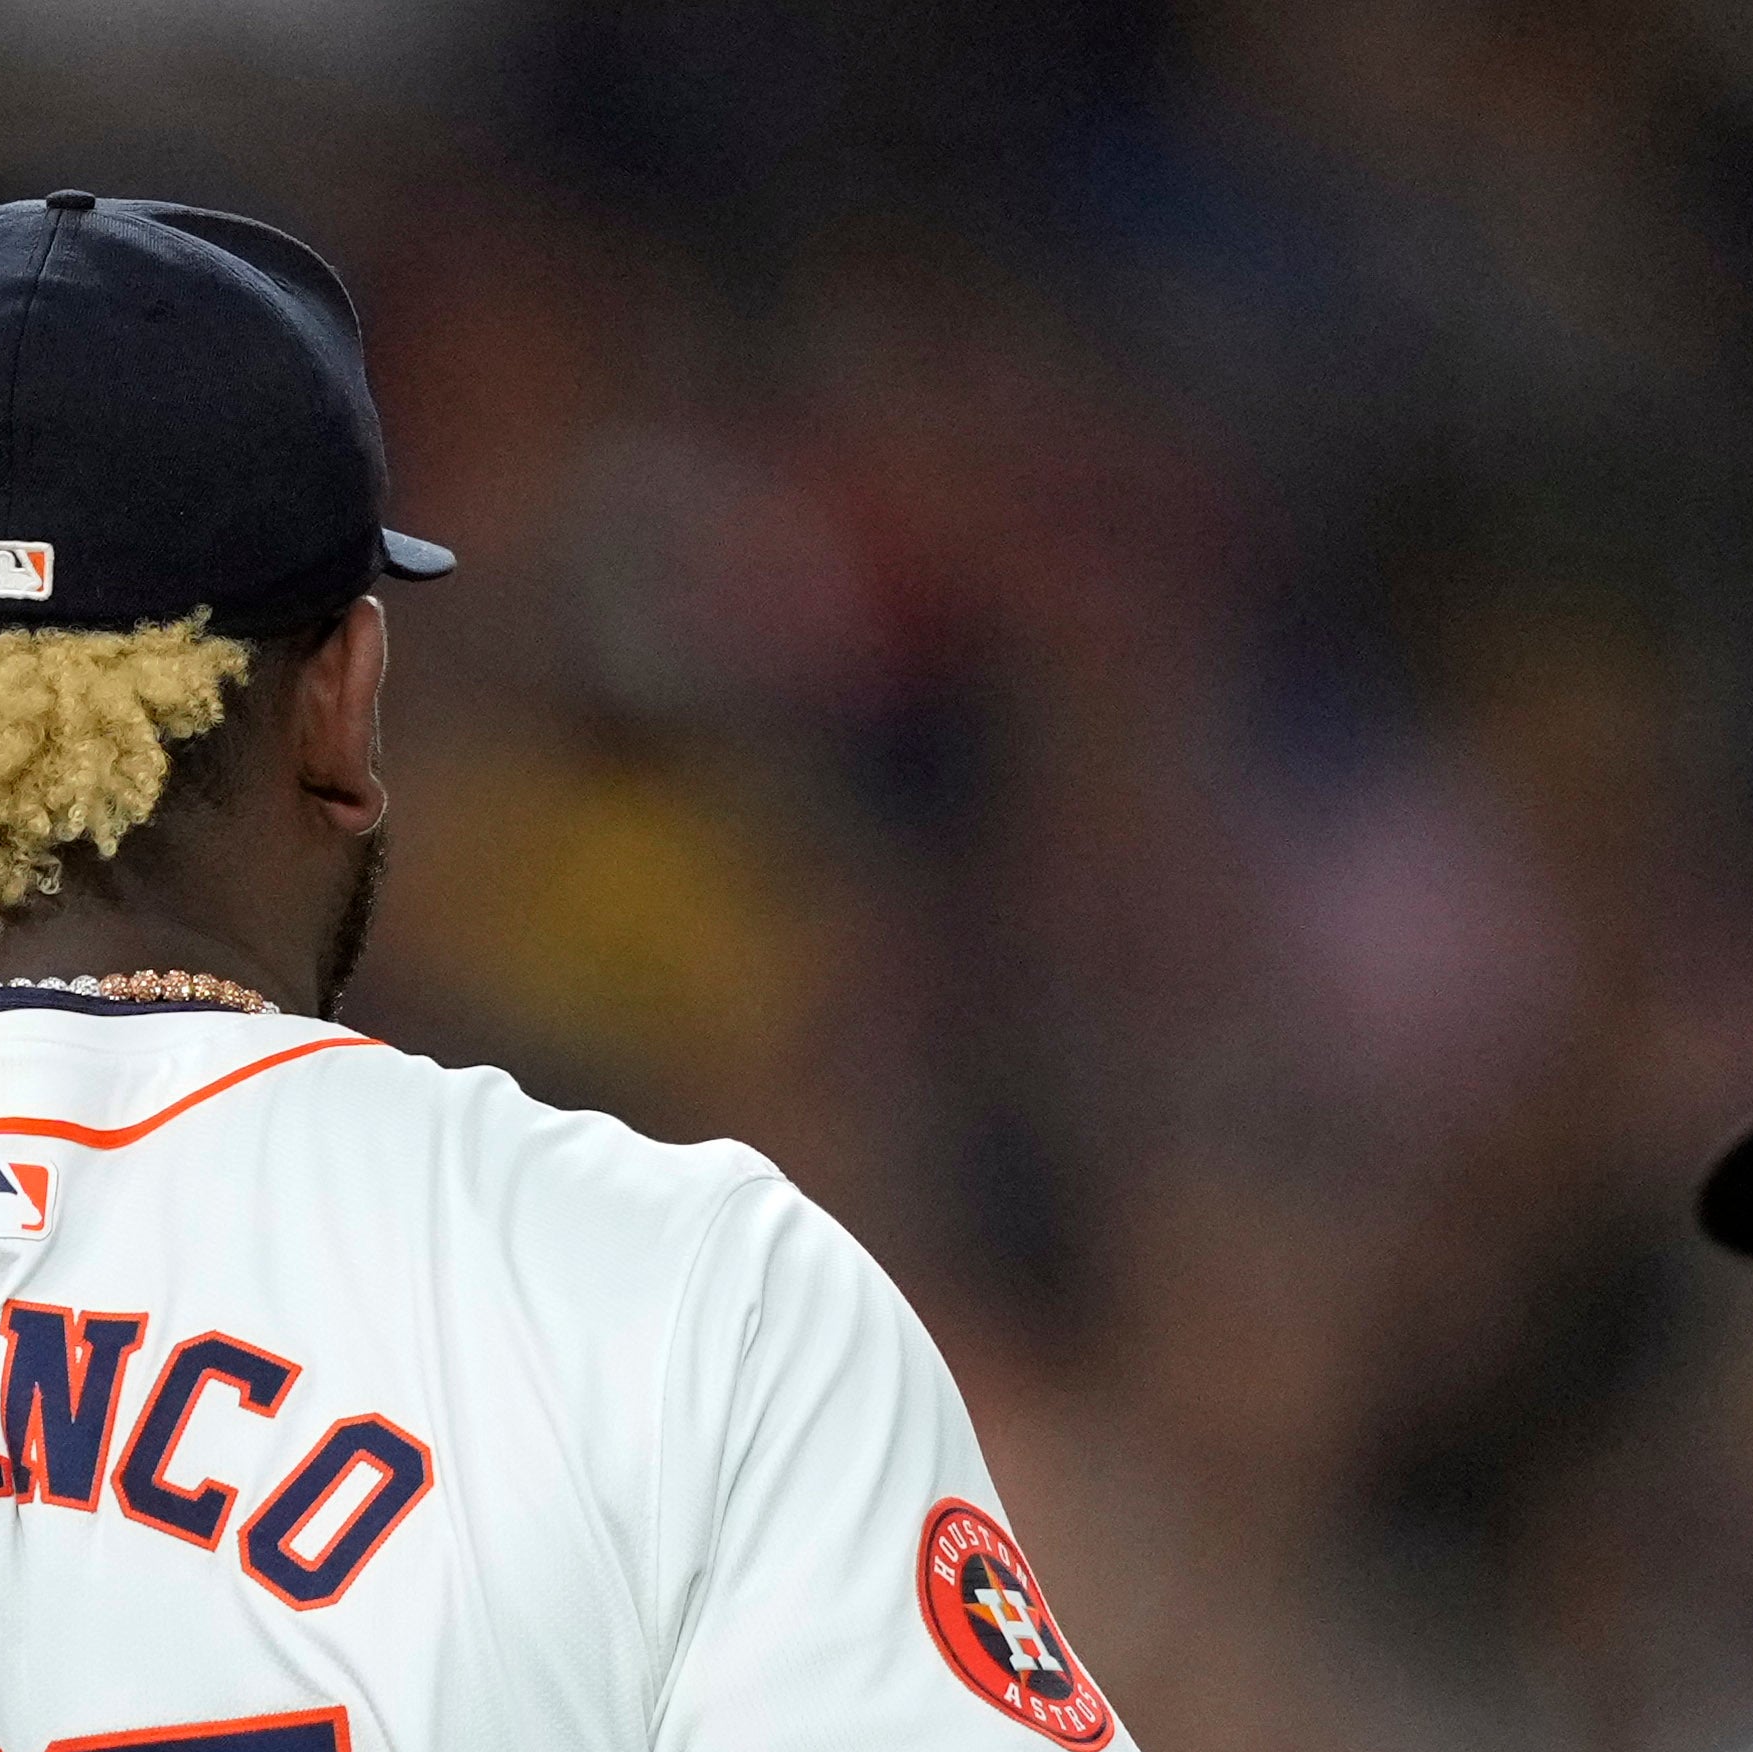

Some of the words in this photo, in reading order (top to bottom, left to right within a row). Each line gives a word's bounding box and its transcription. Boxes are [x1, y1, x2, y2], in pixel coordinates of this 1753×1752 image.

[934, 1519, 1029, 1587] HOUSTON
[974, 1588, 1064, 1671] H
[1003, 1683, 1098, 1732] ASTROS
